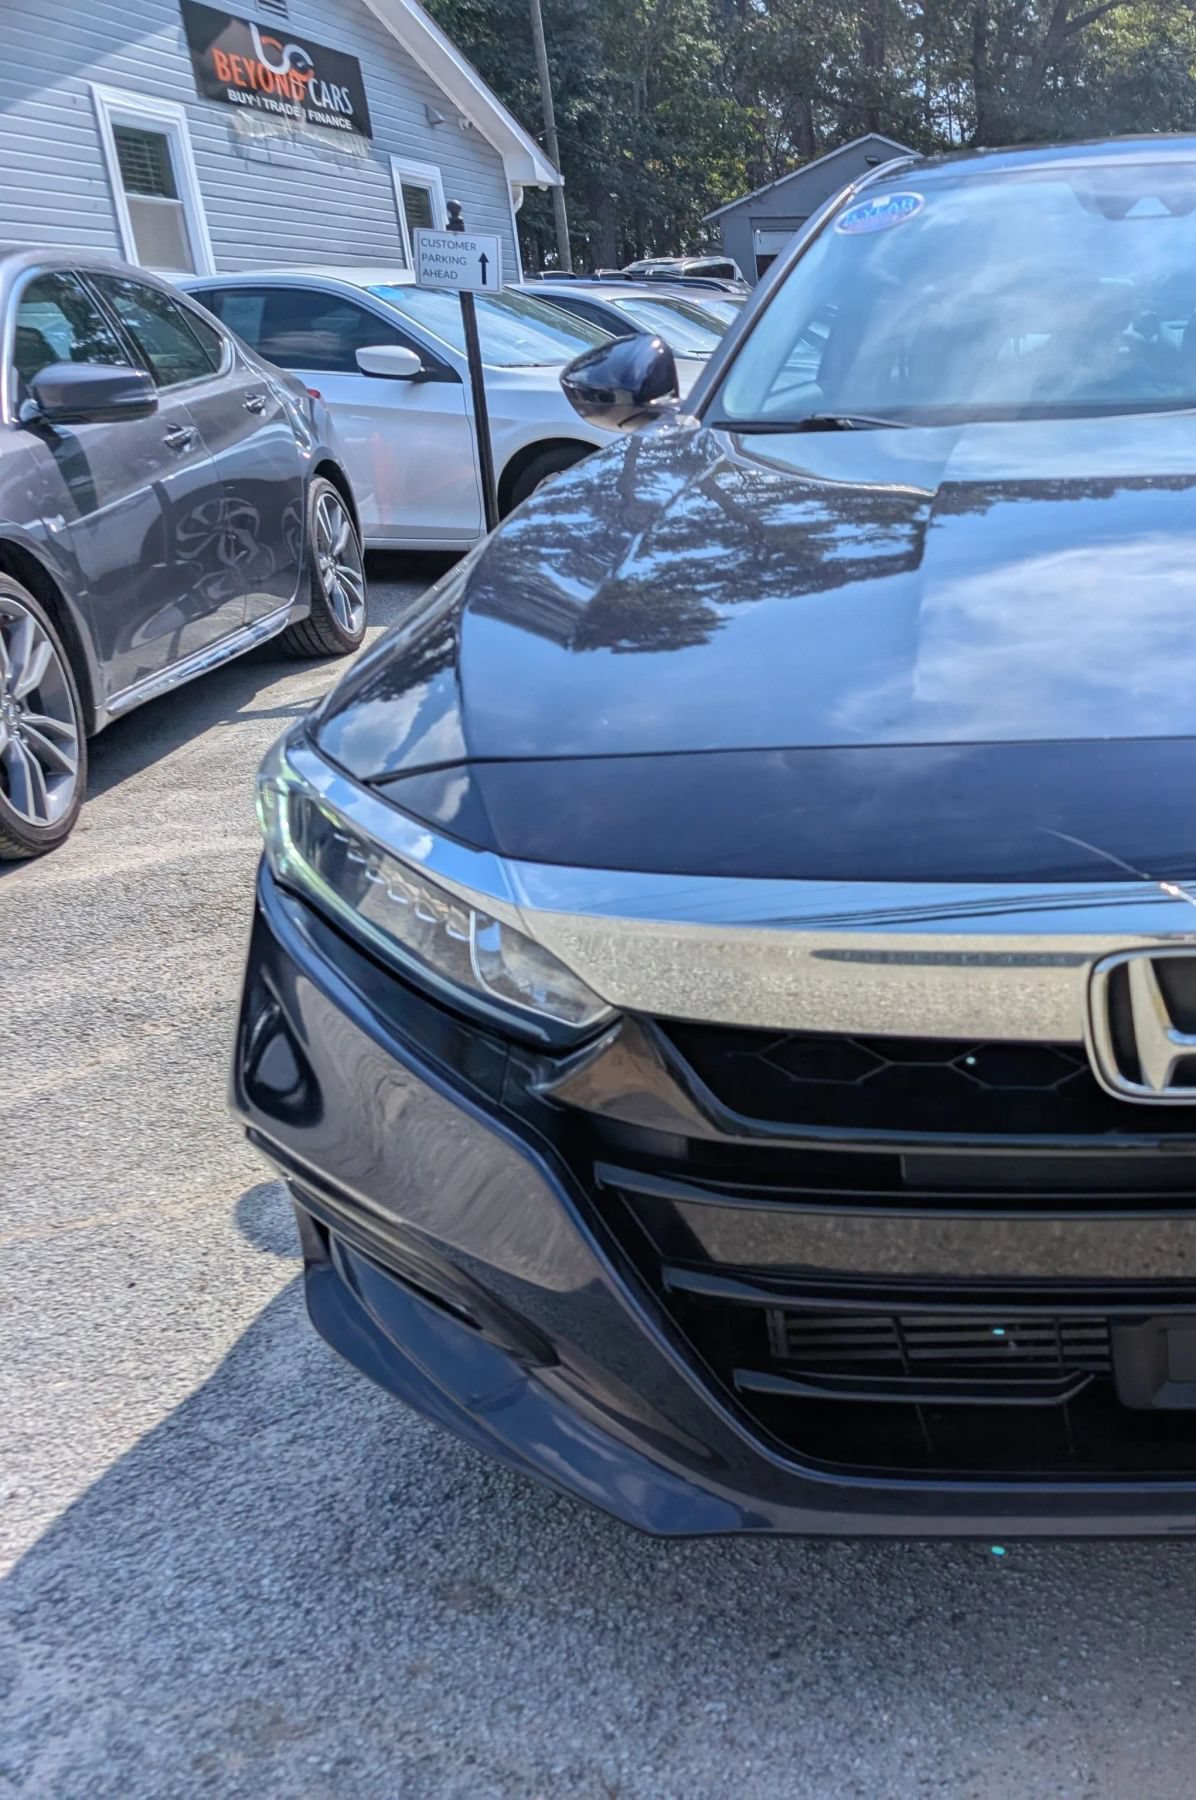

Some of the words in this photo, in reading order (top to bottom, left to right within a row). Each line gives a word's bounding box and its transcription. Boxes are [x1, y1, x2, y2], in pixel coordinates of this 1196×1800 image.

[212, 48, 304, 101] BEYOND
[308, 78, 354, 115] CARS
[262, 98, 301, 117] TRADE
[309, 111, 353, 130] FINANCE
[420, 238, 477, 251] CUSTOMER
[422, 253, 467, 266] PARKING
[423, 268, 458, 279] AHEAD
